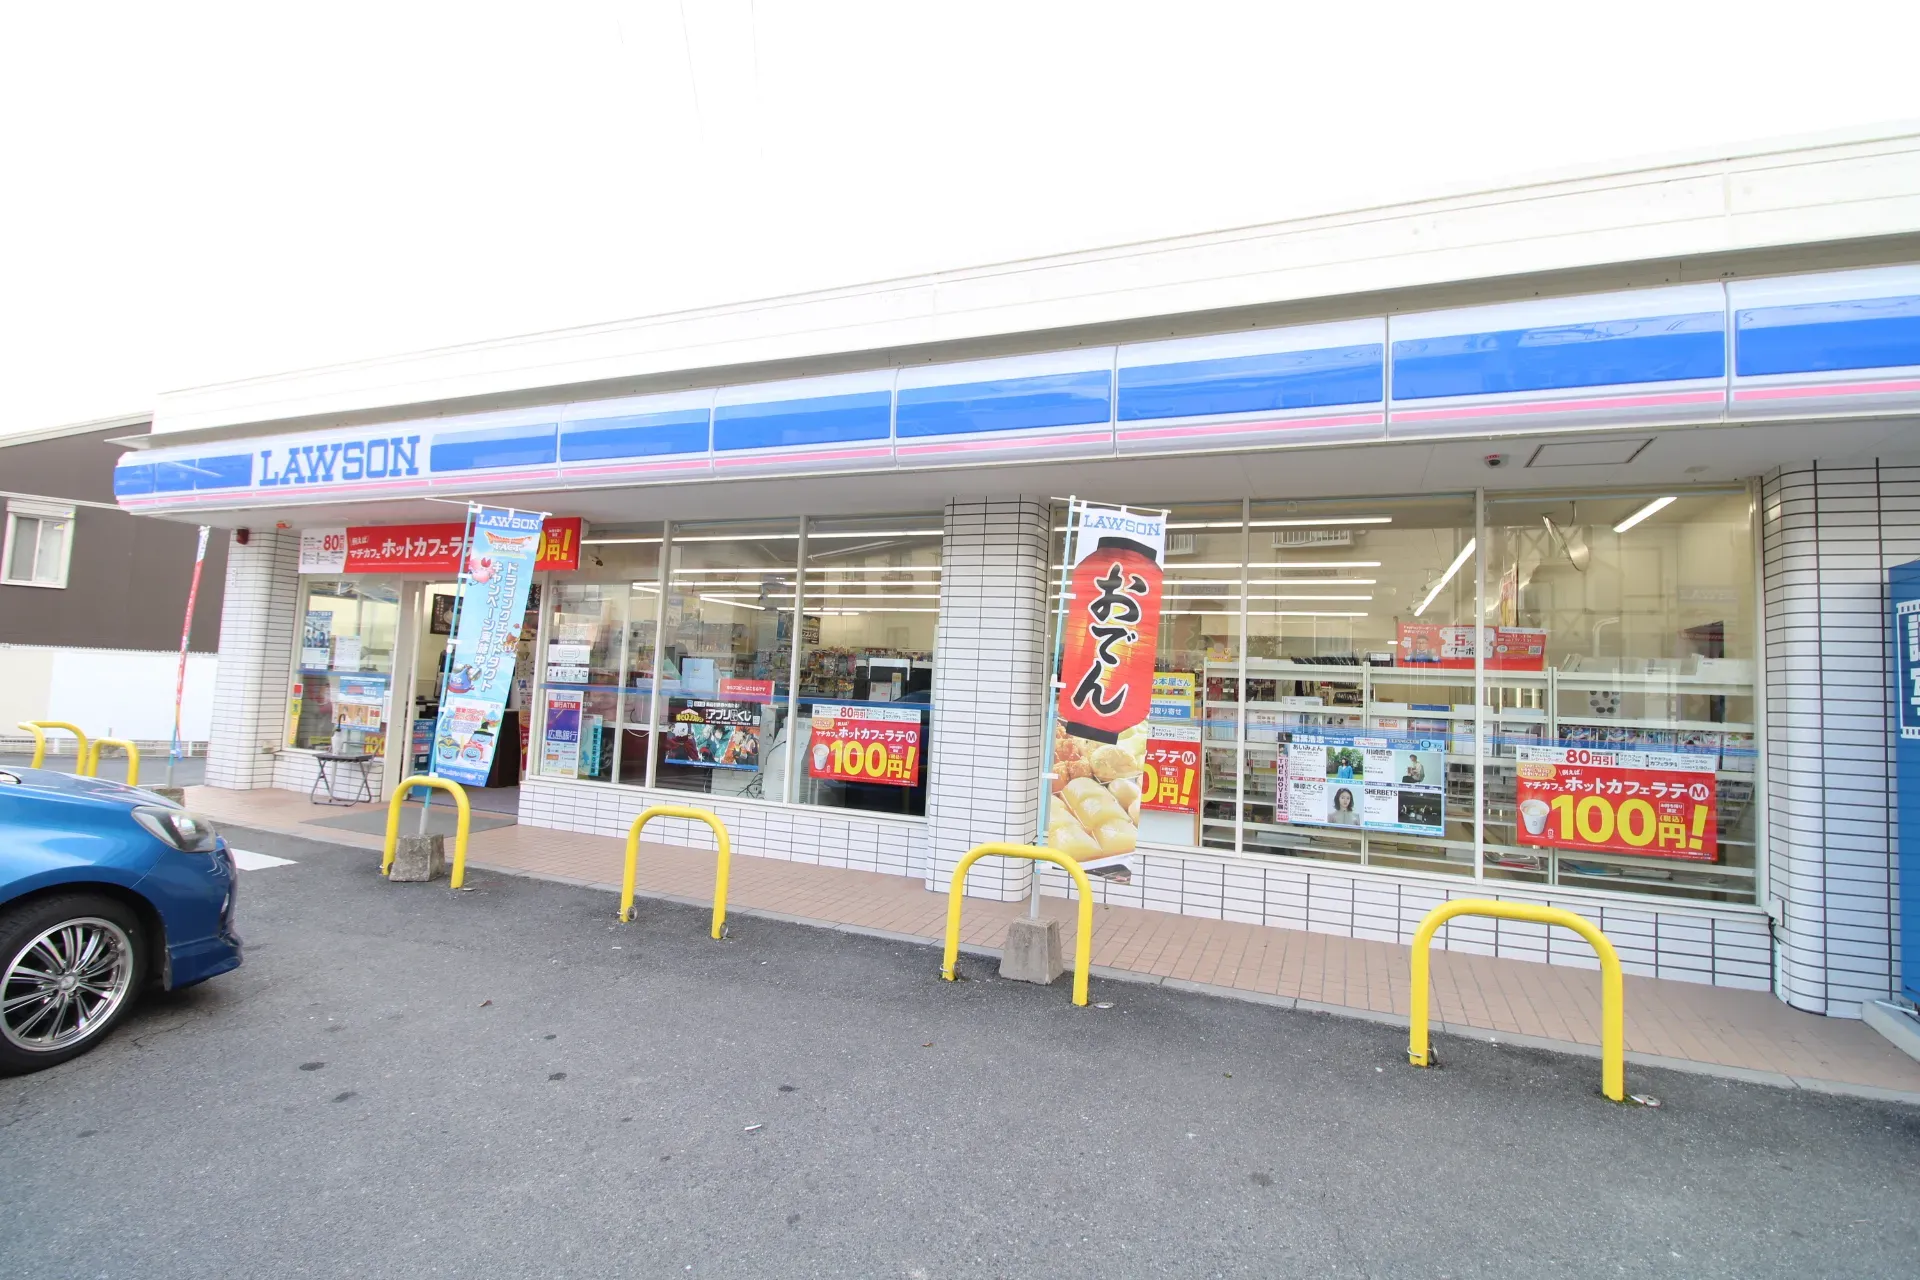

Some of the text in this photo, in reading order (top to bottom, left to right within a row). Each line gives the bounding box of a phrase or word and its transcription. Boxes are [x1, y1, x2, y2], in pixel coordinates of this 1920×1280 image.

[258, 435, 421, 486] LAWSON
[479, 514, 540, 531] LAWSON
[1083, 514, 1161, 537] LAWSON
[382, 537, 472, 558] ホットカフェラ
[474, 561, 503, 665] キャンペーン実施中
[481, 562, 518, 692] ドラゴンクエストタクト
[1072, 562, 1149, 718] おでん
[1450, 647, 1475, 655] クーポ
[840, 706, 866, 719] 80円引
[547, 729, 578, 742] 広島銀行
[839, 727, 906, 742] ホットカフェラテ
[829, 739, 917, 780] 100円!
[1145, 748, 1181, 764] ェラテ
[1565, 749, 1614, 766] 80円引
[1365, 788, 1398, 797] SHERBETS
[1565, 778, 1688, 798] ホットカフェラテ
[1551, 794, 1709, 850] 100円!
[1659, 815, 1684, 823] (税込)
